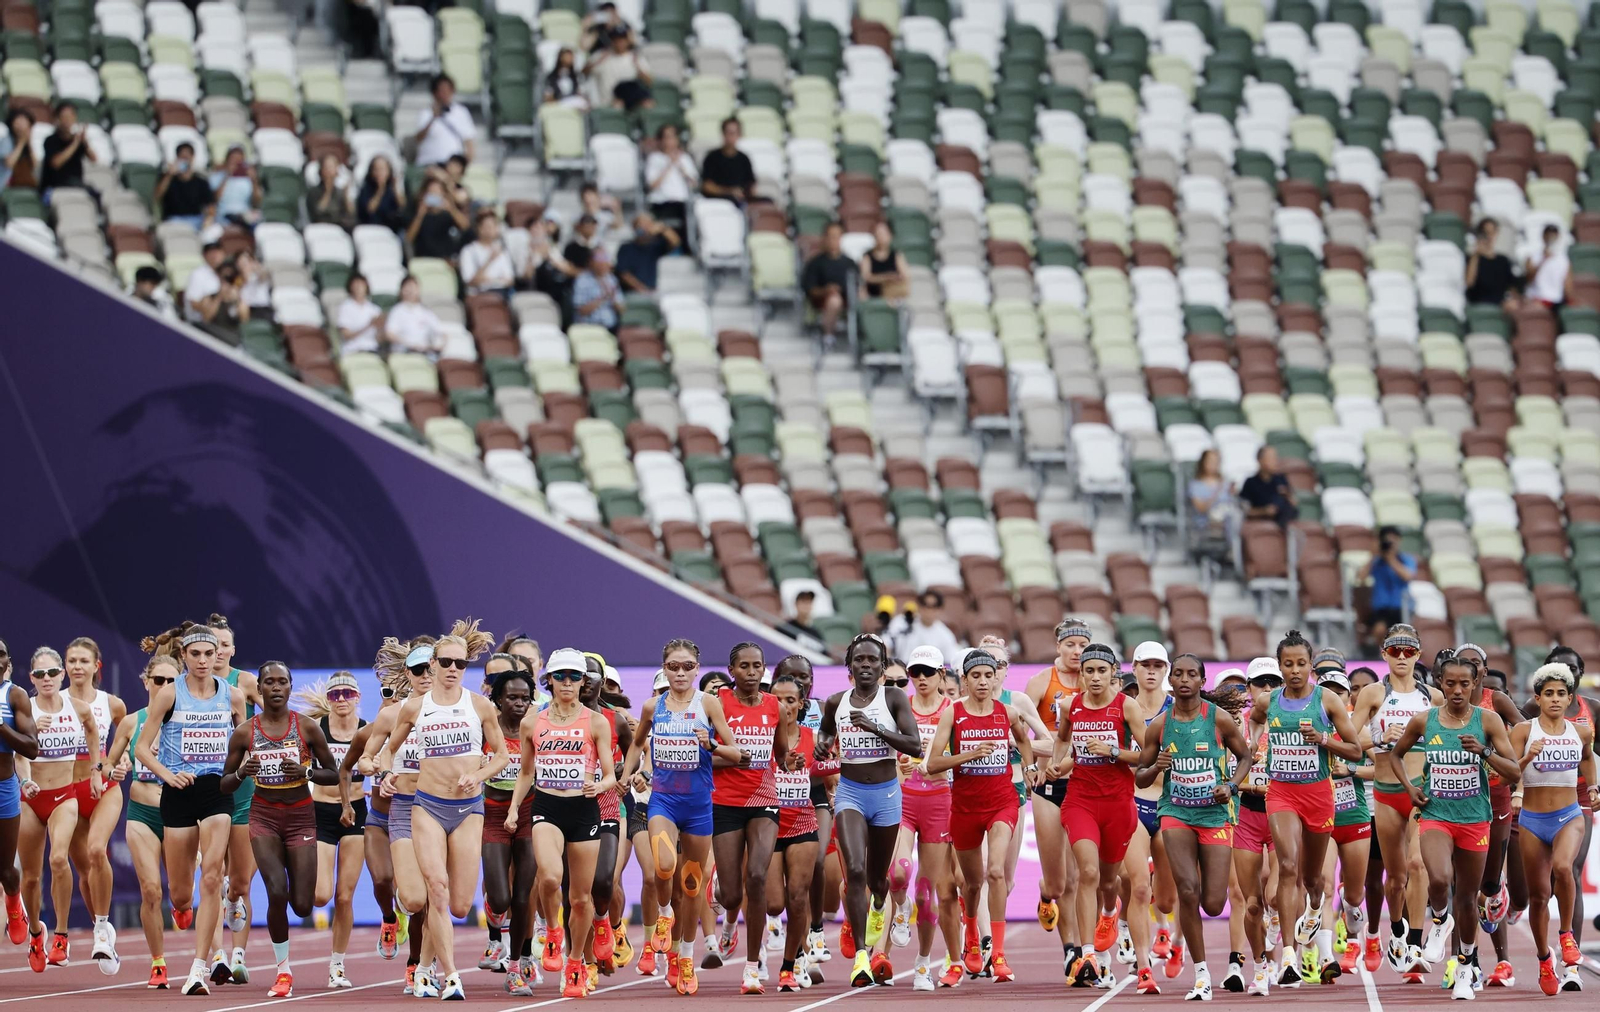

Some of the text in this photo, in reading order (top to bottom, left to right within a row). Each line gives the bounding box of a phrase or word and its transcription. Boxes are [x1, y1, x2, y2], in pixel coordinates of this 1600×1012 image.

[421, 721, 470, 733] HONDA
[655, 722, 695, 734] MONGOLIA
[1073, 721, 1114, 730] MOROCCO
[961, 728, 1004, 738] MOROCCO
[424, 732, 470, 748] SULLIVAN
[537, 740, 583, 751] JAPAN
[654, 737, 697, 746] HONDA
[841, 737, 887, 748] SALPETER
[1543, 738, 1579, 746] ONDA
[183, 742, 225, 753] PATERNAIN
[1272, 748, 1317, 756] HONDA
[259, 751, 298, 761] ONDA
[655, 749, 697, 761] BAYARTSOGT
[746, 749, 771, 760] HAW
[1426, 750, 1481, 764] ETHIOPIA
[817, 760, 840, 770] CHIN
[1272, 760, 1317, 772] KETEMA
[1431, 766, 1479, 775] HONDA
[500, 767, 521, 778] CHIR
[541, 768, 580, 779] ANDO
[775, 776, 809, 784] ONDA
[1171, 774, 1215, 783] HONDA
[1433, 776, 1478, 789] KEBEDE
[1172, 785, 1214, 798] ASSEFA
[1336, 802, 1356, 811] YO25
